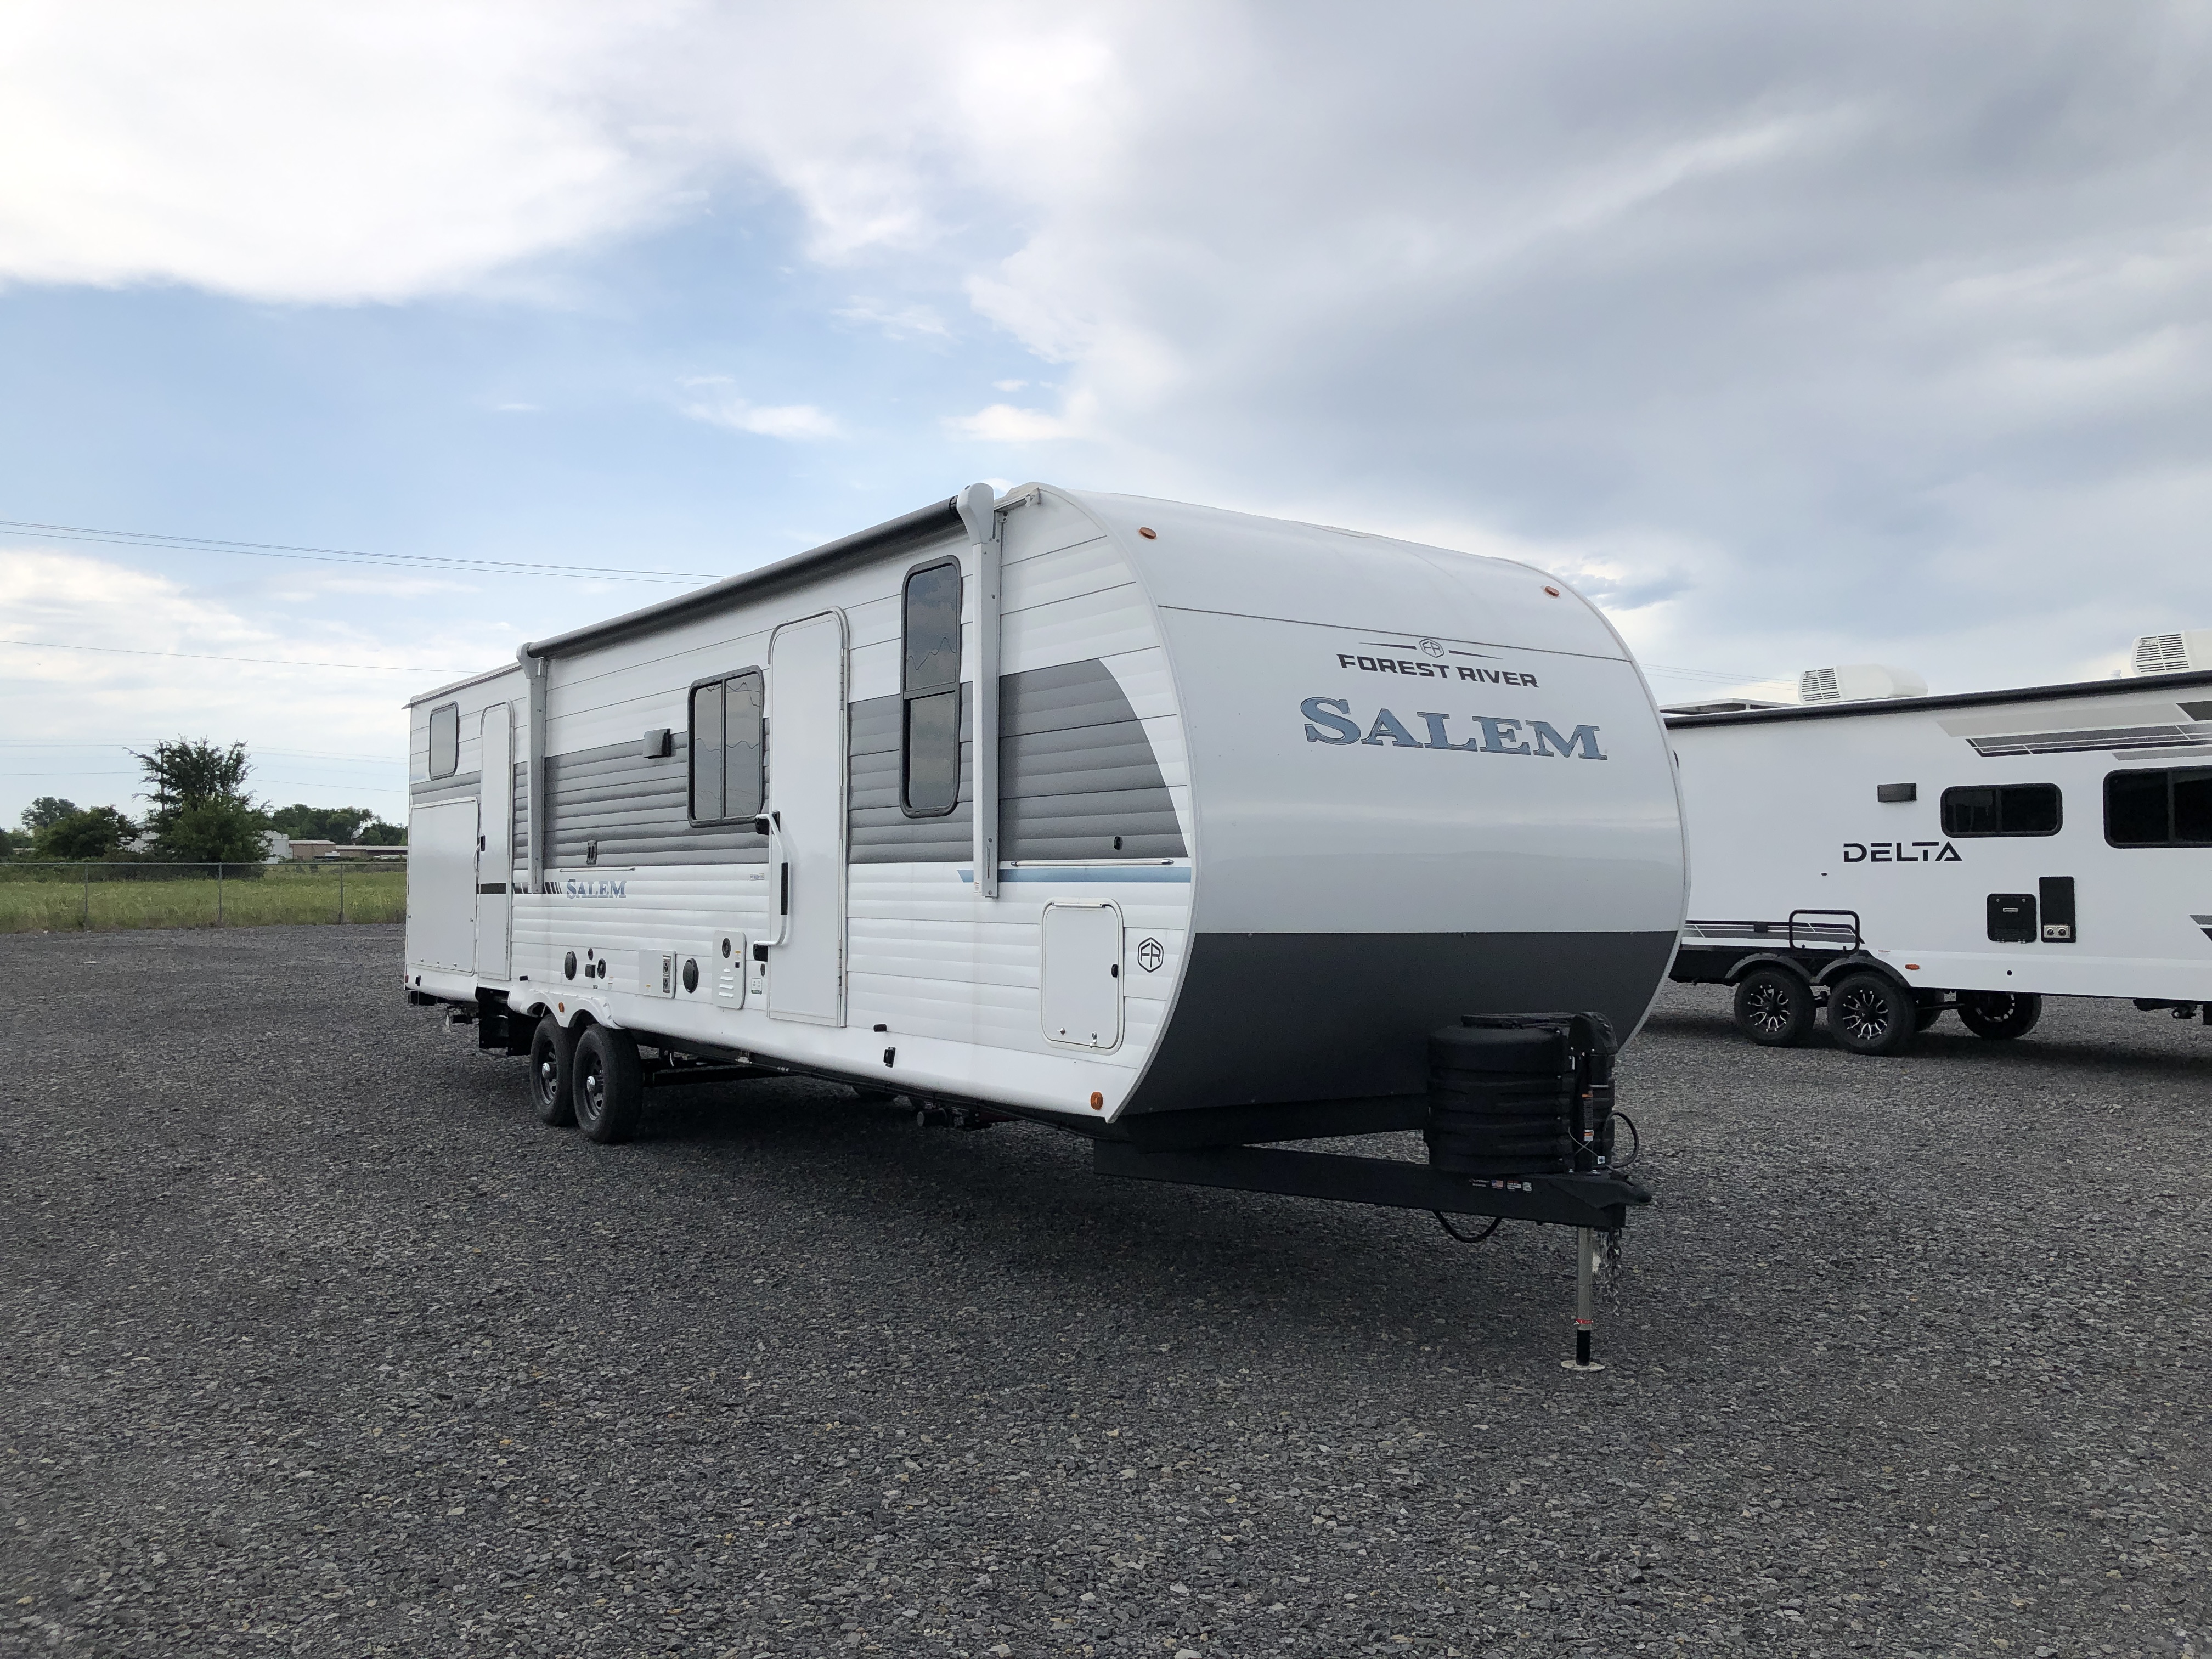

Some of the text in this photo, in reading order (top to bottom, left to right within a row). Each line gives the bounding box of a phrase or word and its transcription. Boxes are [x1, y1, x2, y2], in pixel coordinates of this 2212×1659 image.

[1336, 654, 1539, 688] FOREST RIVER
[1300, 697, 1608, 760] SALEM
[1843, 840, 1963, 862] DELTA
[566, 878, 627, 899] SALEM
